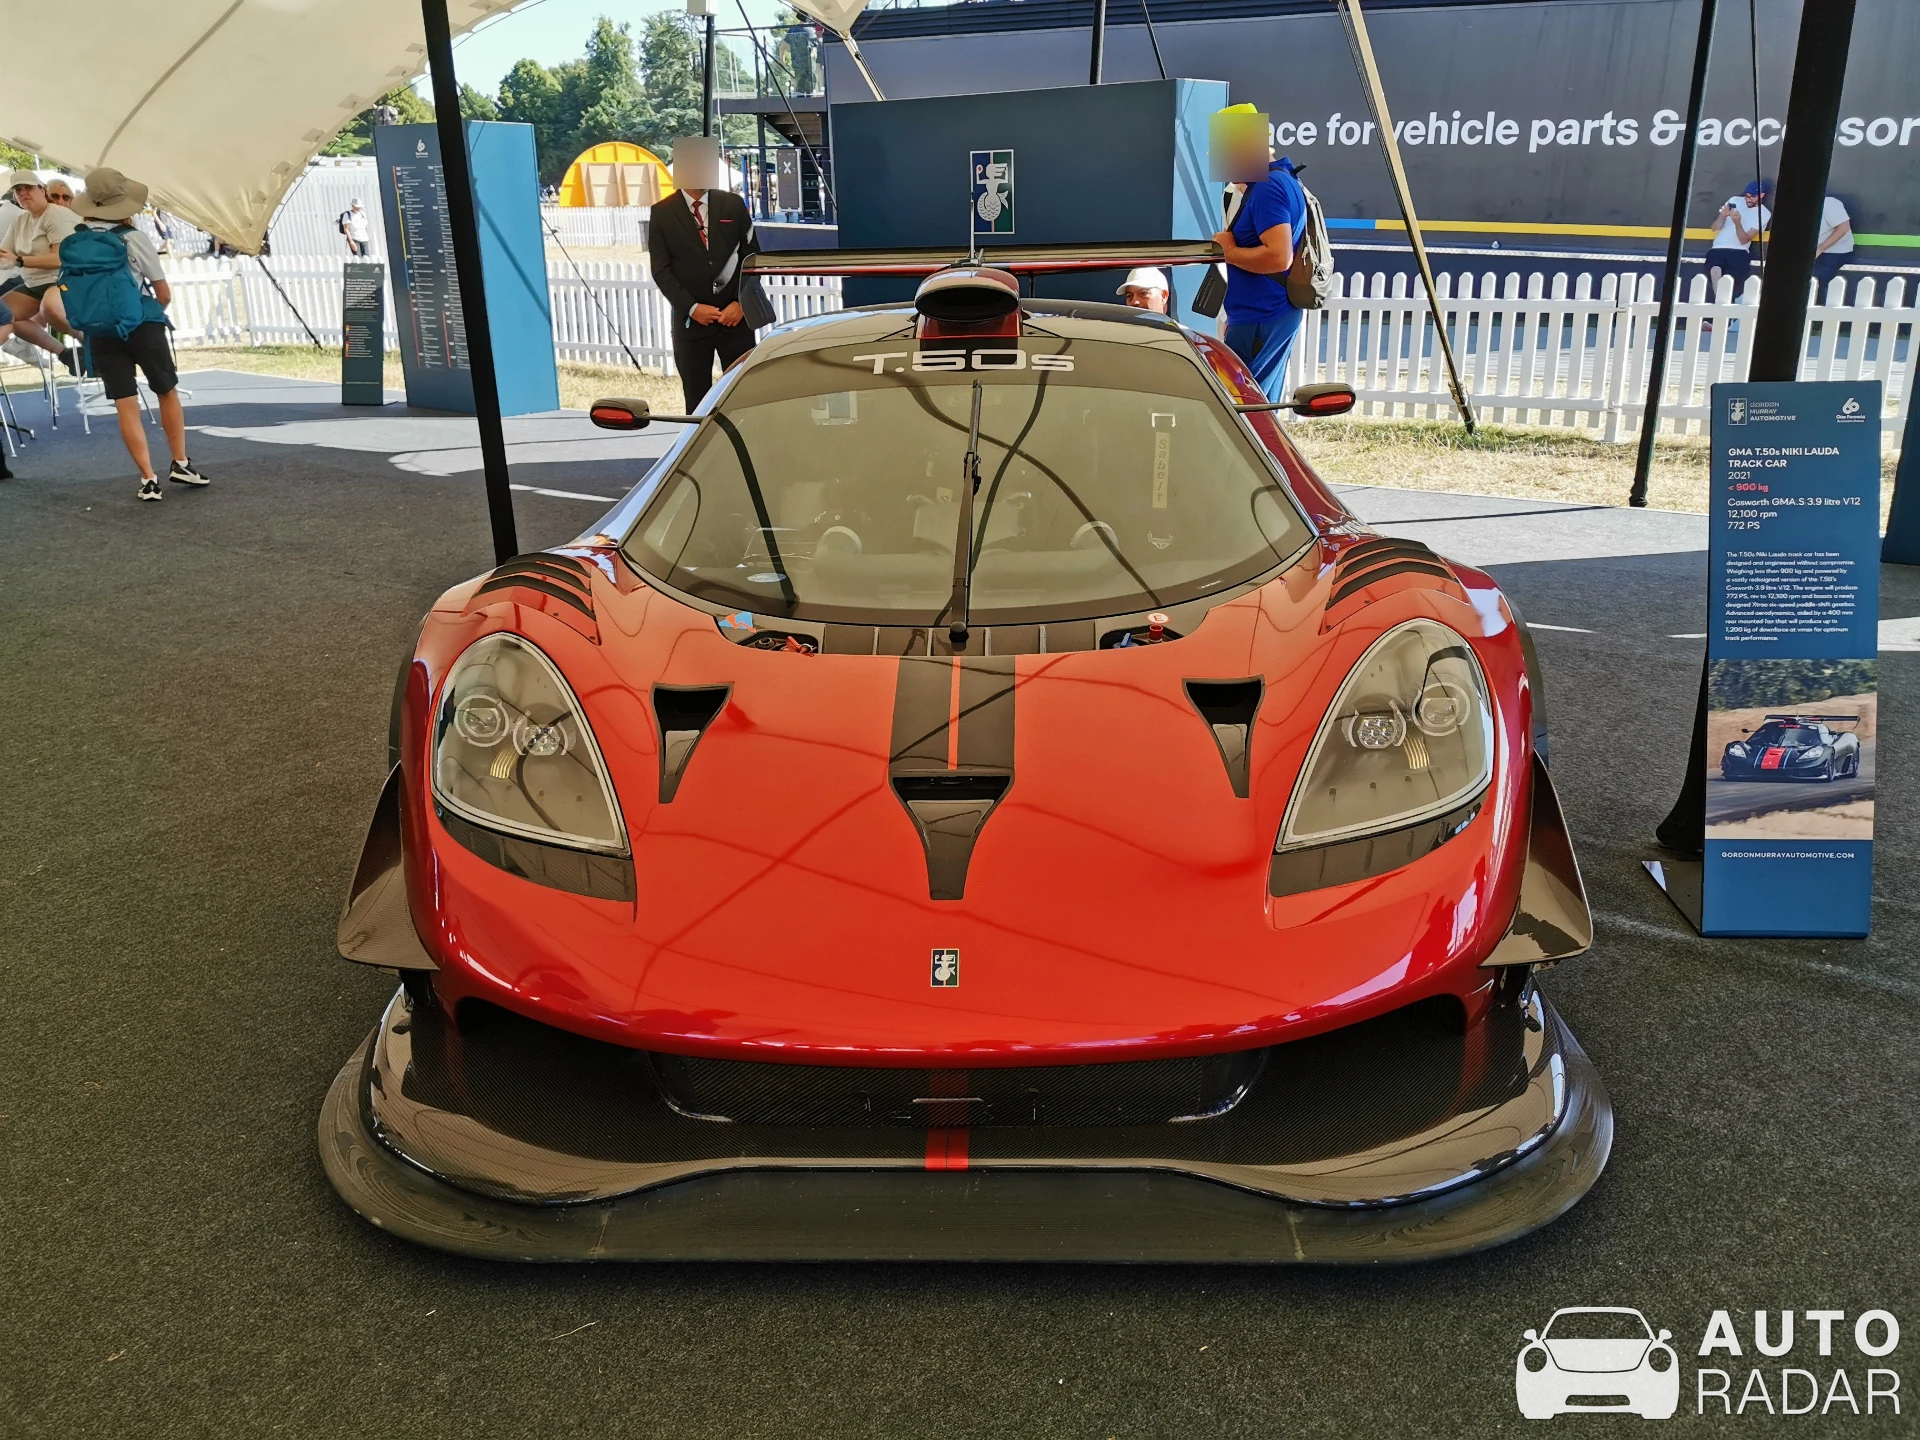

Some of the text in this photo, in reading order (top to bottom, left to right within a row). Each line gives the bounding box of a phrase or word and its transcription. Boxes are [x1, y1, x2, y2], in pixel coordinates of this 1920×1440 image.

[1269, 120, 1317, 146] ce
[1326, 112, 1376, 146] for
[1528, 110, 1639, 153] parts
[1650, 109, 1687, 146] &
[1697, 116, 1920, 146] accsor
[1728, 447, 1840, 456] GMA T.50s NIKI LAUDA
[1728, 460, 1787, 468] TRACK CAR
[1728, 471, 1751, 480] 2021
[1736, 483, 1756, 491] 900
[1758, 483, 1769, 492] kg
[1727, 497, 1860, 506] Cosworth GMA.S 3.9 litre V12
[1728, 510, 1778, 519] 12,100 rpm
[1727, 521, 1760, 530] 772 PS
[1721, 851, 1855, 859] GORDONMURRAYAUTOMOTIVE.COM
